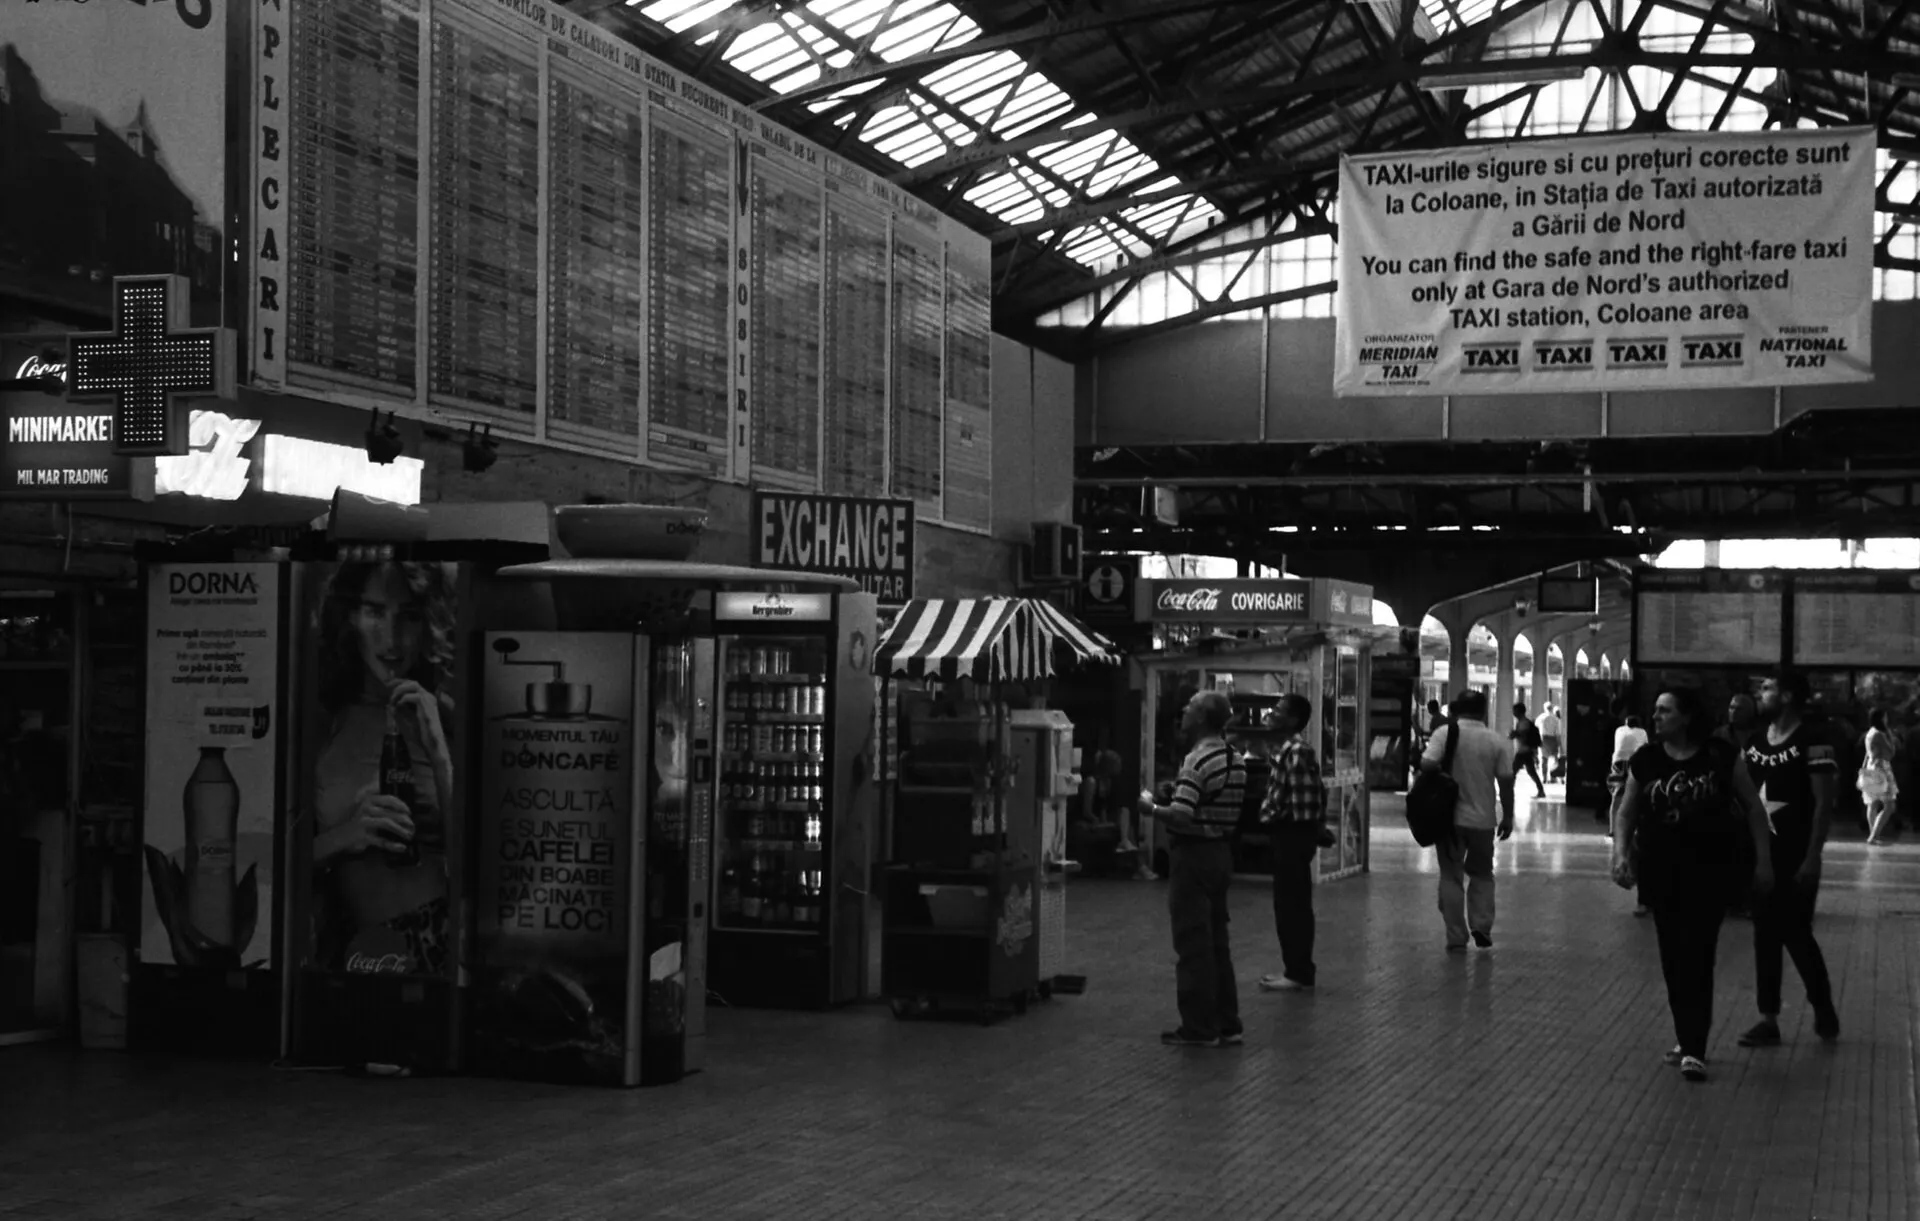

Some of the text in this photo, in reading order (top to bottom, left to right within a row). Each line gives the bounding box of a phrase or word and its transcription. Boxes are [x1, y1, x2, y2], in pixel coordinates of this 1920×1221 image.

[551, 13, 566, 37] DE
[1363, 141, 1850, 186] TAXI-urile sigure si cu prețuri corecte sunt
[260, 24, 280, 361] PLECARI
[1386, 172, 1824, 214] la Coloane, in Stația de Taxi autorizată
[1512, 207, 1685, 237] a Gării de Nord
[1361, 256, 1401, 277] You
[1408, 255, 1447, 274] can
[1454, 249, 1496, 273] find
[1503, 248, 1537, 270] the
[1544, 245, 1591, 269] safe
[1598, 243, 1641, 266] and
[1647, 242, 1684, 264] the
[1803, 236, 1847, 259] taxi
[1411, 268, 1789, 306] only at Gara de Nord's authorized
[1450, 303, 1749, 329] TAXI station, Coloane area
[1364, 333, 1435, 345] ORGANIZATOR
[1760, 337, 1849, 353] NATIONAL
[1359, 345, 1439, 362] MERIDIAN
[1464, 341, 1741, 367] TAXI TAXI TAXI TAXI
[1785, 354, 1827, 368] TAXI
[1382, 365, 1418, 379] TAXI
[17, 468, 108, 485] MIL MAR TRADING
[761, 497, 907, 571] EXCHANGE
[169, 572, 258, 594] DORNA
[1157, 587, 1304, 612] Coca-Cola COVRIGARIE
[501, 728, 587, 743] MOMENTUL
[517, 818, 615, 841] SUNETUL
[498, 840, 615, 866] CAFELEI
[500, 864, 615, 887] DIN BOABE
[498, 905, 535, 928] PE
